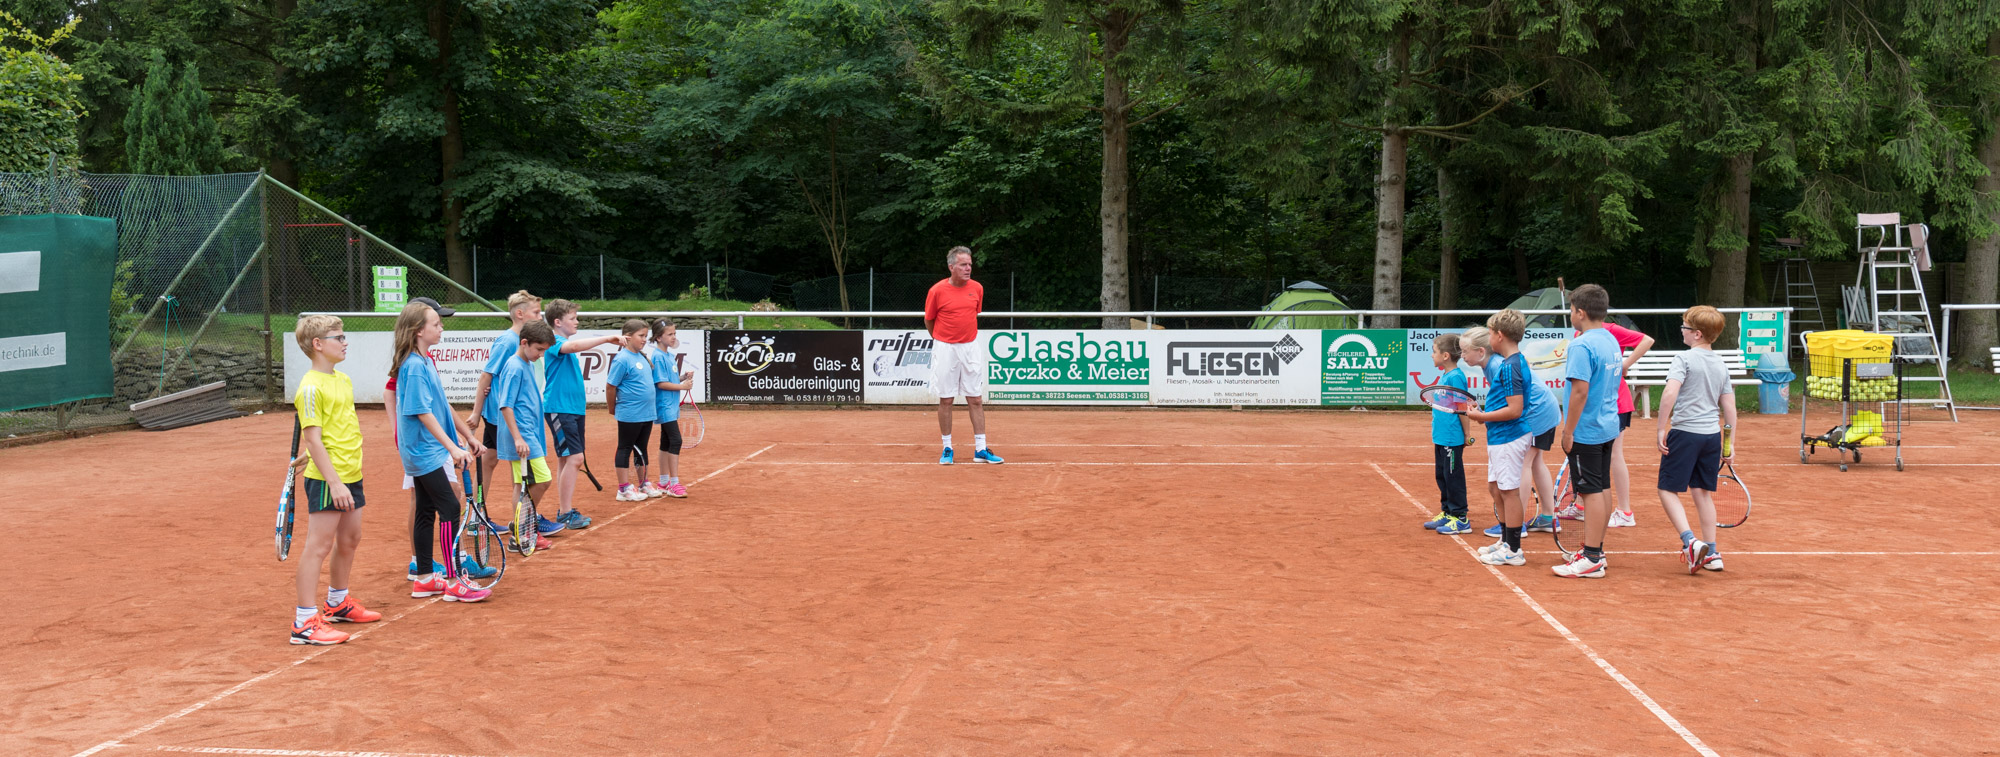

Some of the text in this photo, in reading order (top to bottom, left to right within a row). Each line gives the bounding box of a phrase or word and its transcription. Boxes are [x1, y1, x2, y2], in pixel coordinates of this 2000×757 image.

[1524, 330, 1564, 339] Seesen
[868, 332, 933, 366] reifen
[988, 332, 1149, 362] Glasbau
[1410, 342, 1428, 352] Tel.
[460, 348, 489, 362] PARTYA
[717, 345, 796, 367] TopClean
[1167, 342, 1279, 376] FLIESEN
[813, 357, 861, 371] Glas- &
[1327, 357, 1389, 369] SALAU
[989, 363, 1149, 384] Ryczko & Meier
[748, 375, 861, 392] Gebäudereinigung
[717, 394, 774, 402] www.topclean.net
[990, 392, 1030, 400] Bollergasse
